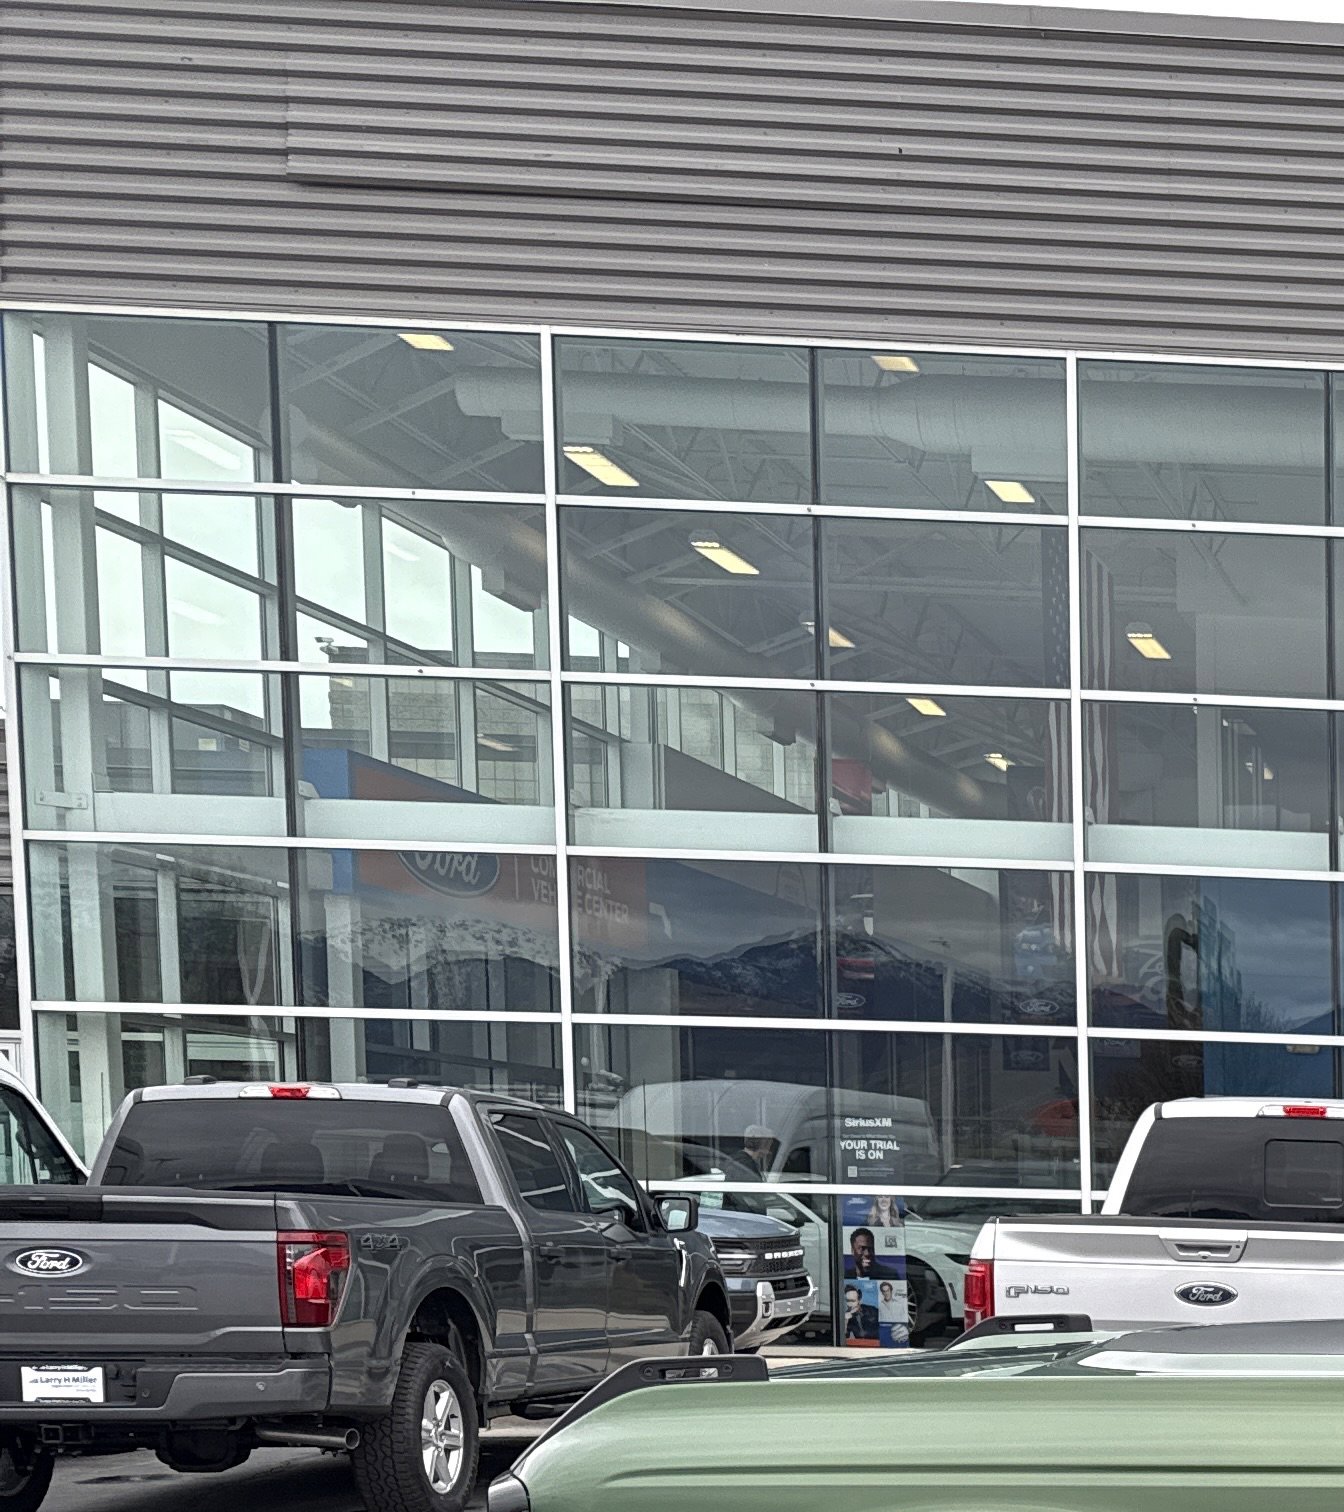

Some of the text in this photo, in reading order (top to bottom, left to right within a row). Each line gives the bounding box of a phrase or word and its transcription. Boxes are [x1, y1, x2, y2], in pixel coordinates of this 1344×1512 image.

[585, 900, 629, 923] CENTER
[844, 1117, 893, 1128] SiriusXM
[840, 1139, 900, 1151] YOUR TRIAL
[855, 1150, 884, 1160] IS ON
[26, 1249, 72, 1271] Ford
